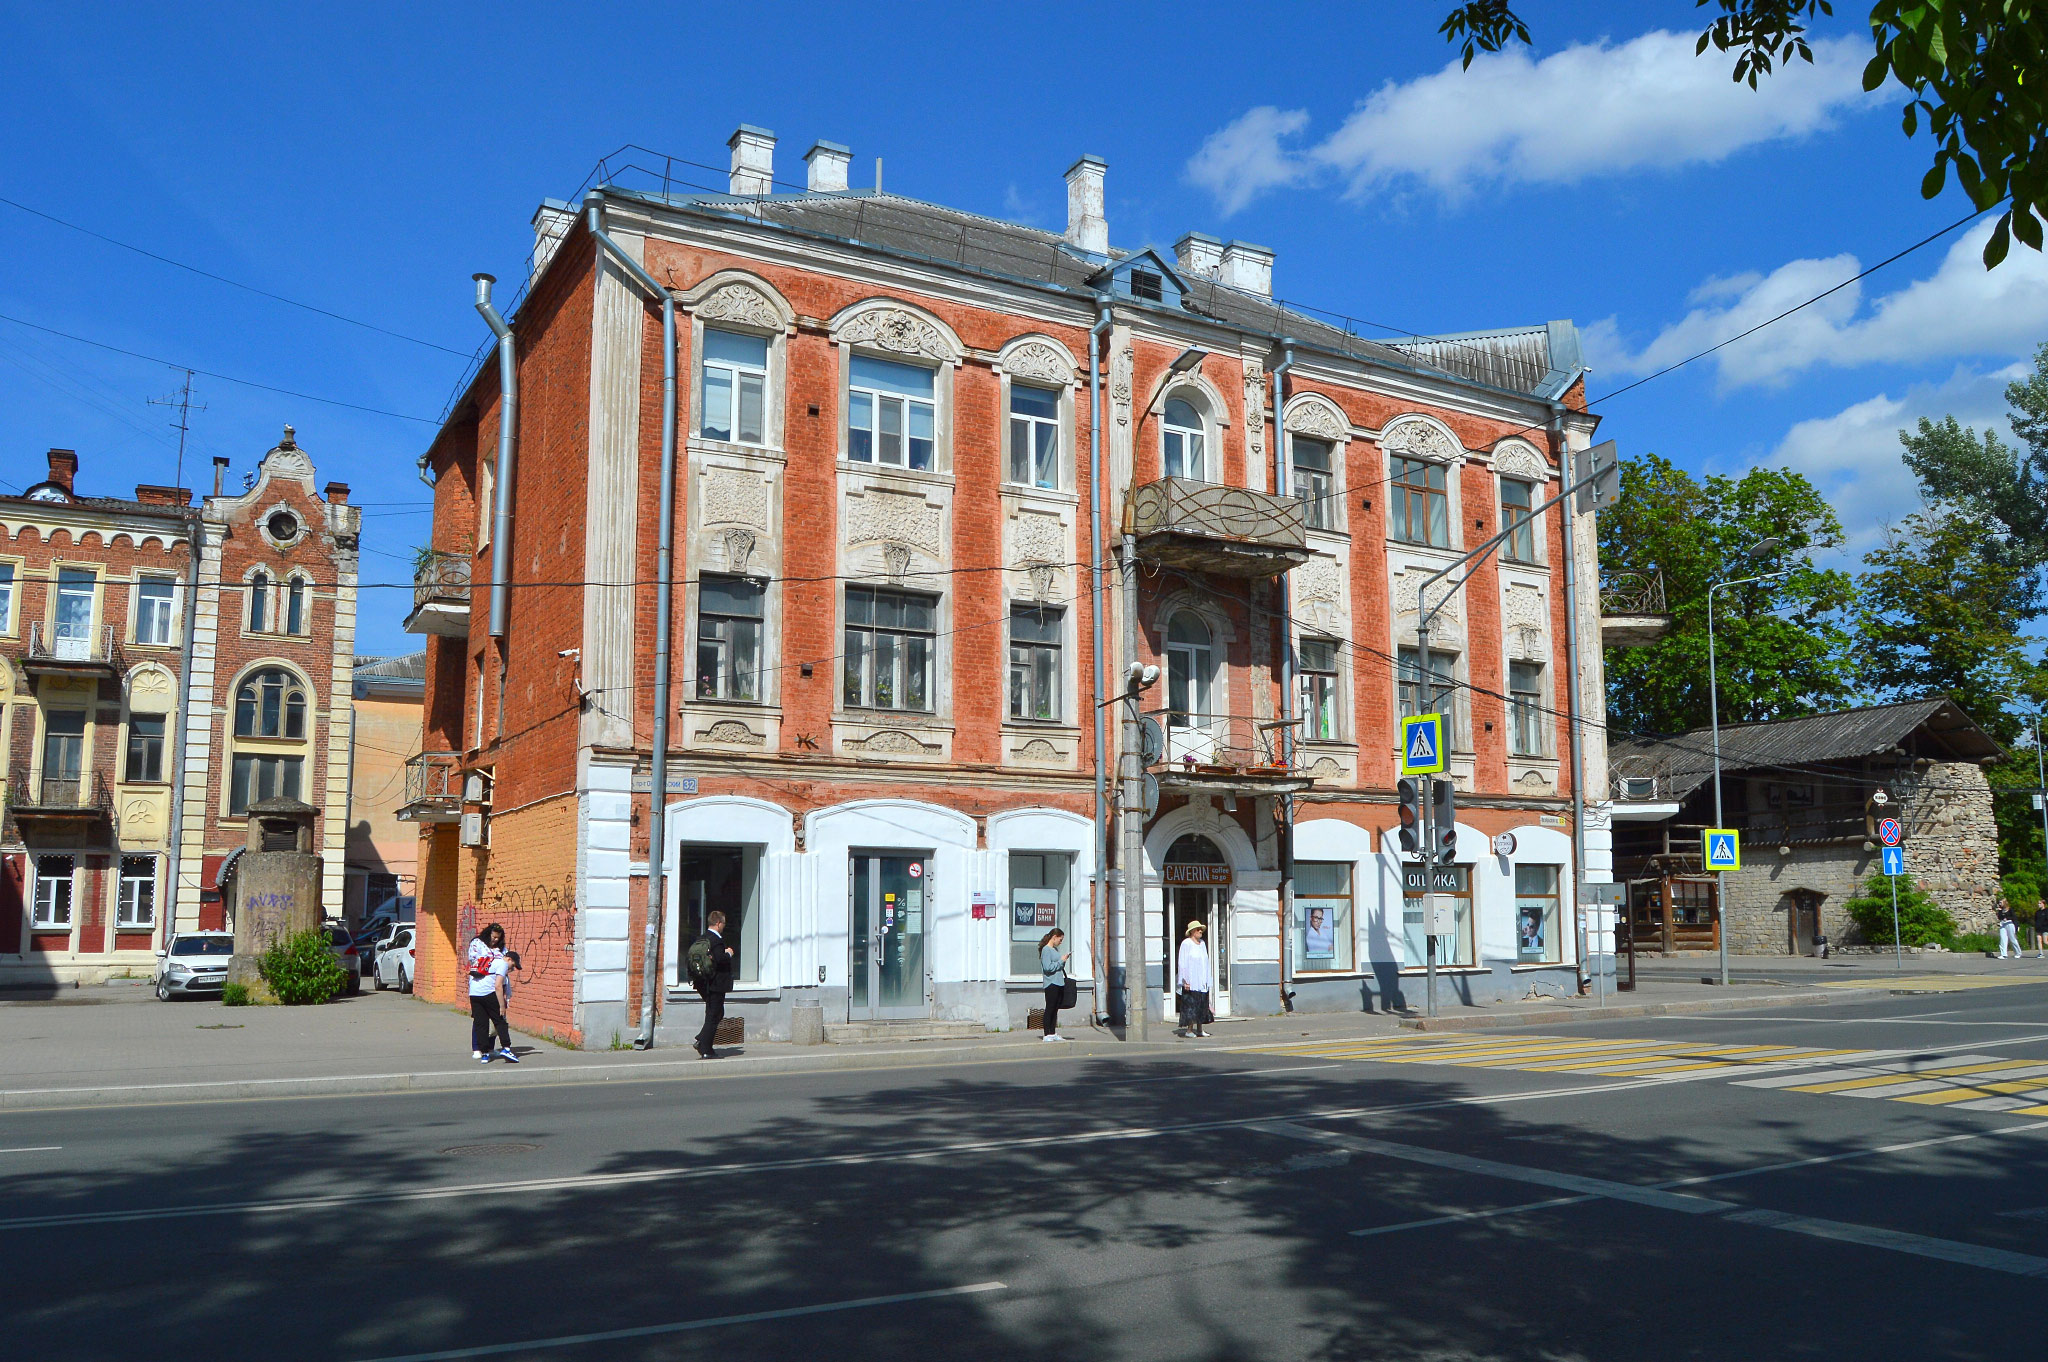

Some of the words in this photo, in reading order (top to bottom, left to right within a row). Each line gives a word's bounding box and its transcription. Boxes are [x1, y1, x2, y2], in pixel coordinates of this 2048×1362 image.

[683, 780, 695, 790] 32
[1166, 865, 1210, 881] CAVERIN
[1212, 866, 1229, 874] coffee
[1408, 874, 1456, 887] ОПИКА
[1037, 907, 1054, 915] ПОЧТА
[1037, 914, 1052, 922] БАНК
